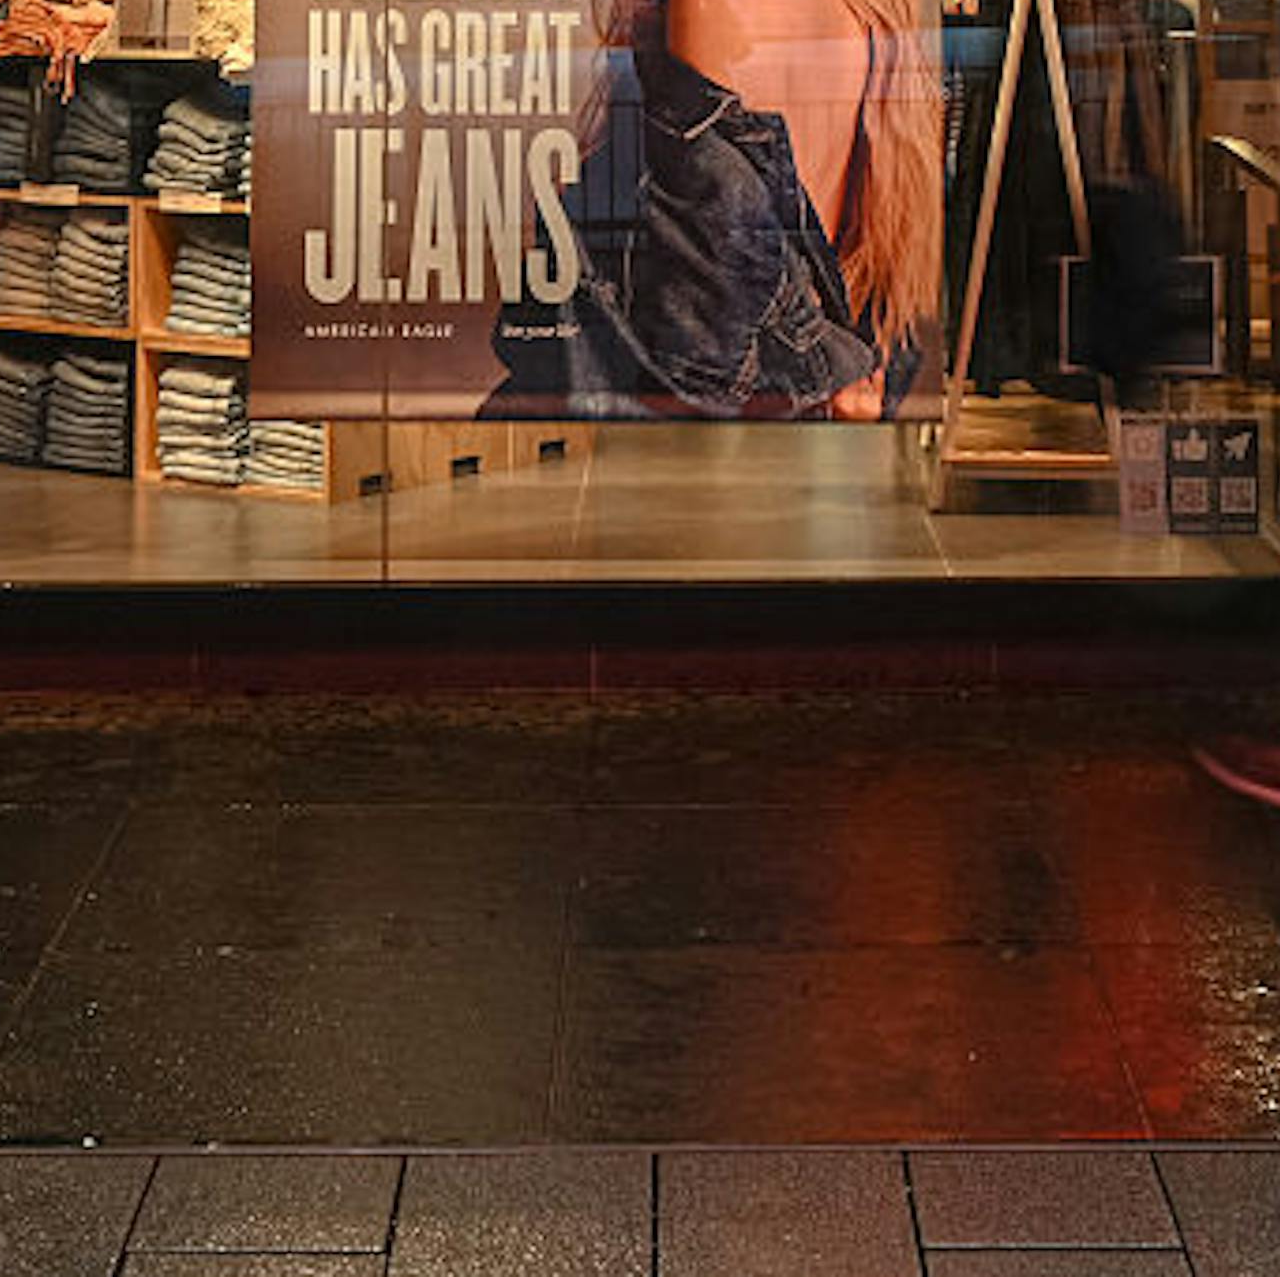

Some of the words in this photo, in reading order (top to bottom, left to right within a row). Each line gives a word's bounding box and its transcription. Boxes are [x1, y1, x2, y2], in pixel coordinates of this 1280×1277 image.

[308, 9, 409, 115] HAS
[420, 9, 581, 116] GREAT
[304, 127, 581, 304] JEANS
